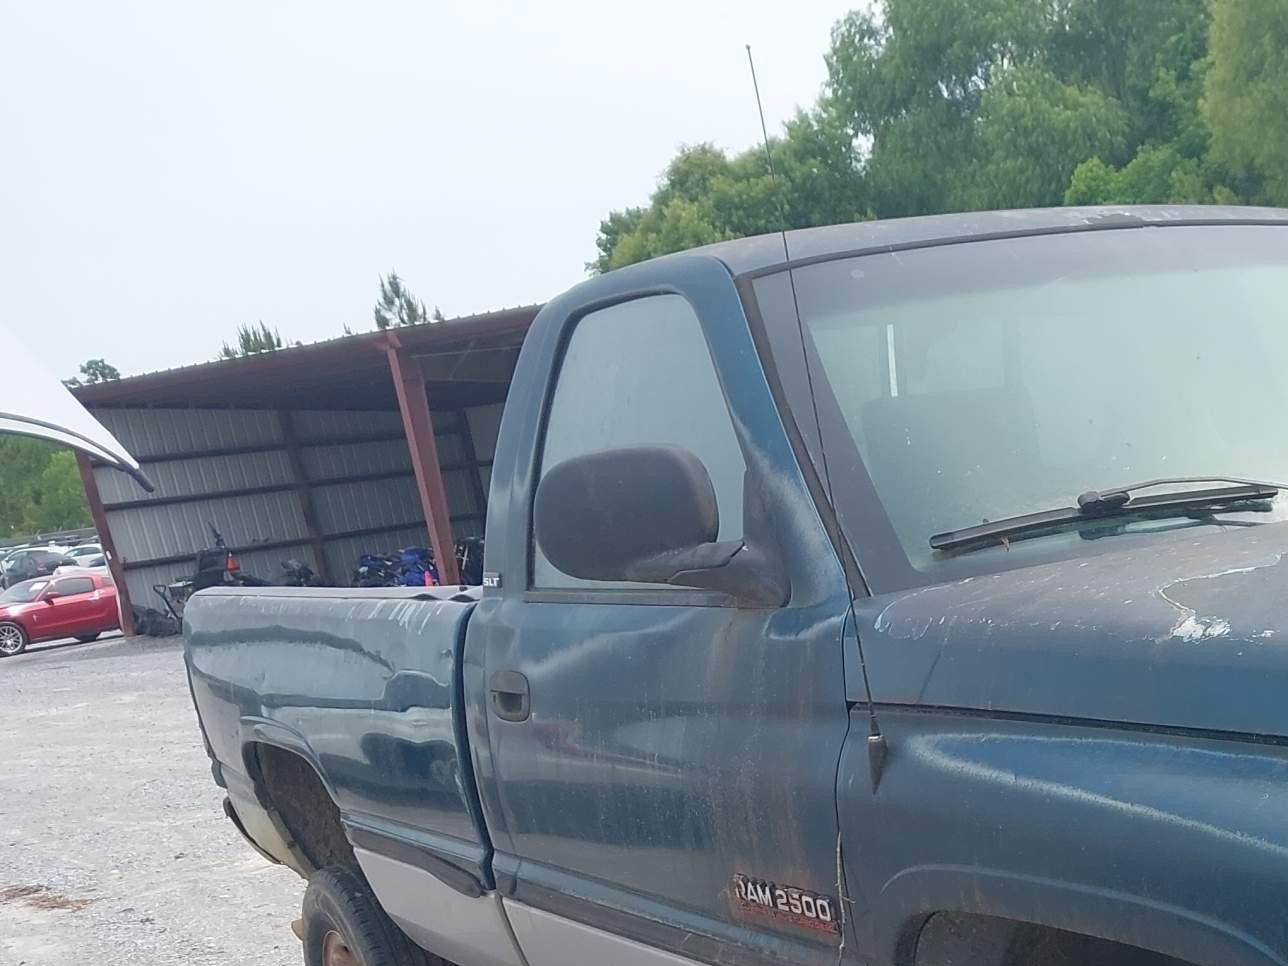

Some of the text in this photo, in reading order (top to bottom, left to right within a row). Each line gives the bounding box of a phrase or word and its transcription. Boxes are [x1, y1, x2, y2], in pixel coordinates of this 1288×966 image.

[483, 577, 500, 587] SLT
[734, 876, 774, 907] RAM
[775, 889, 832, 922] 2500
